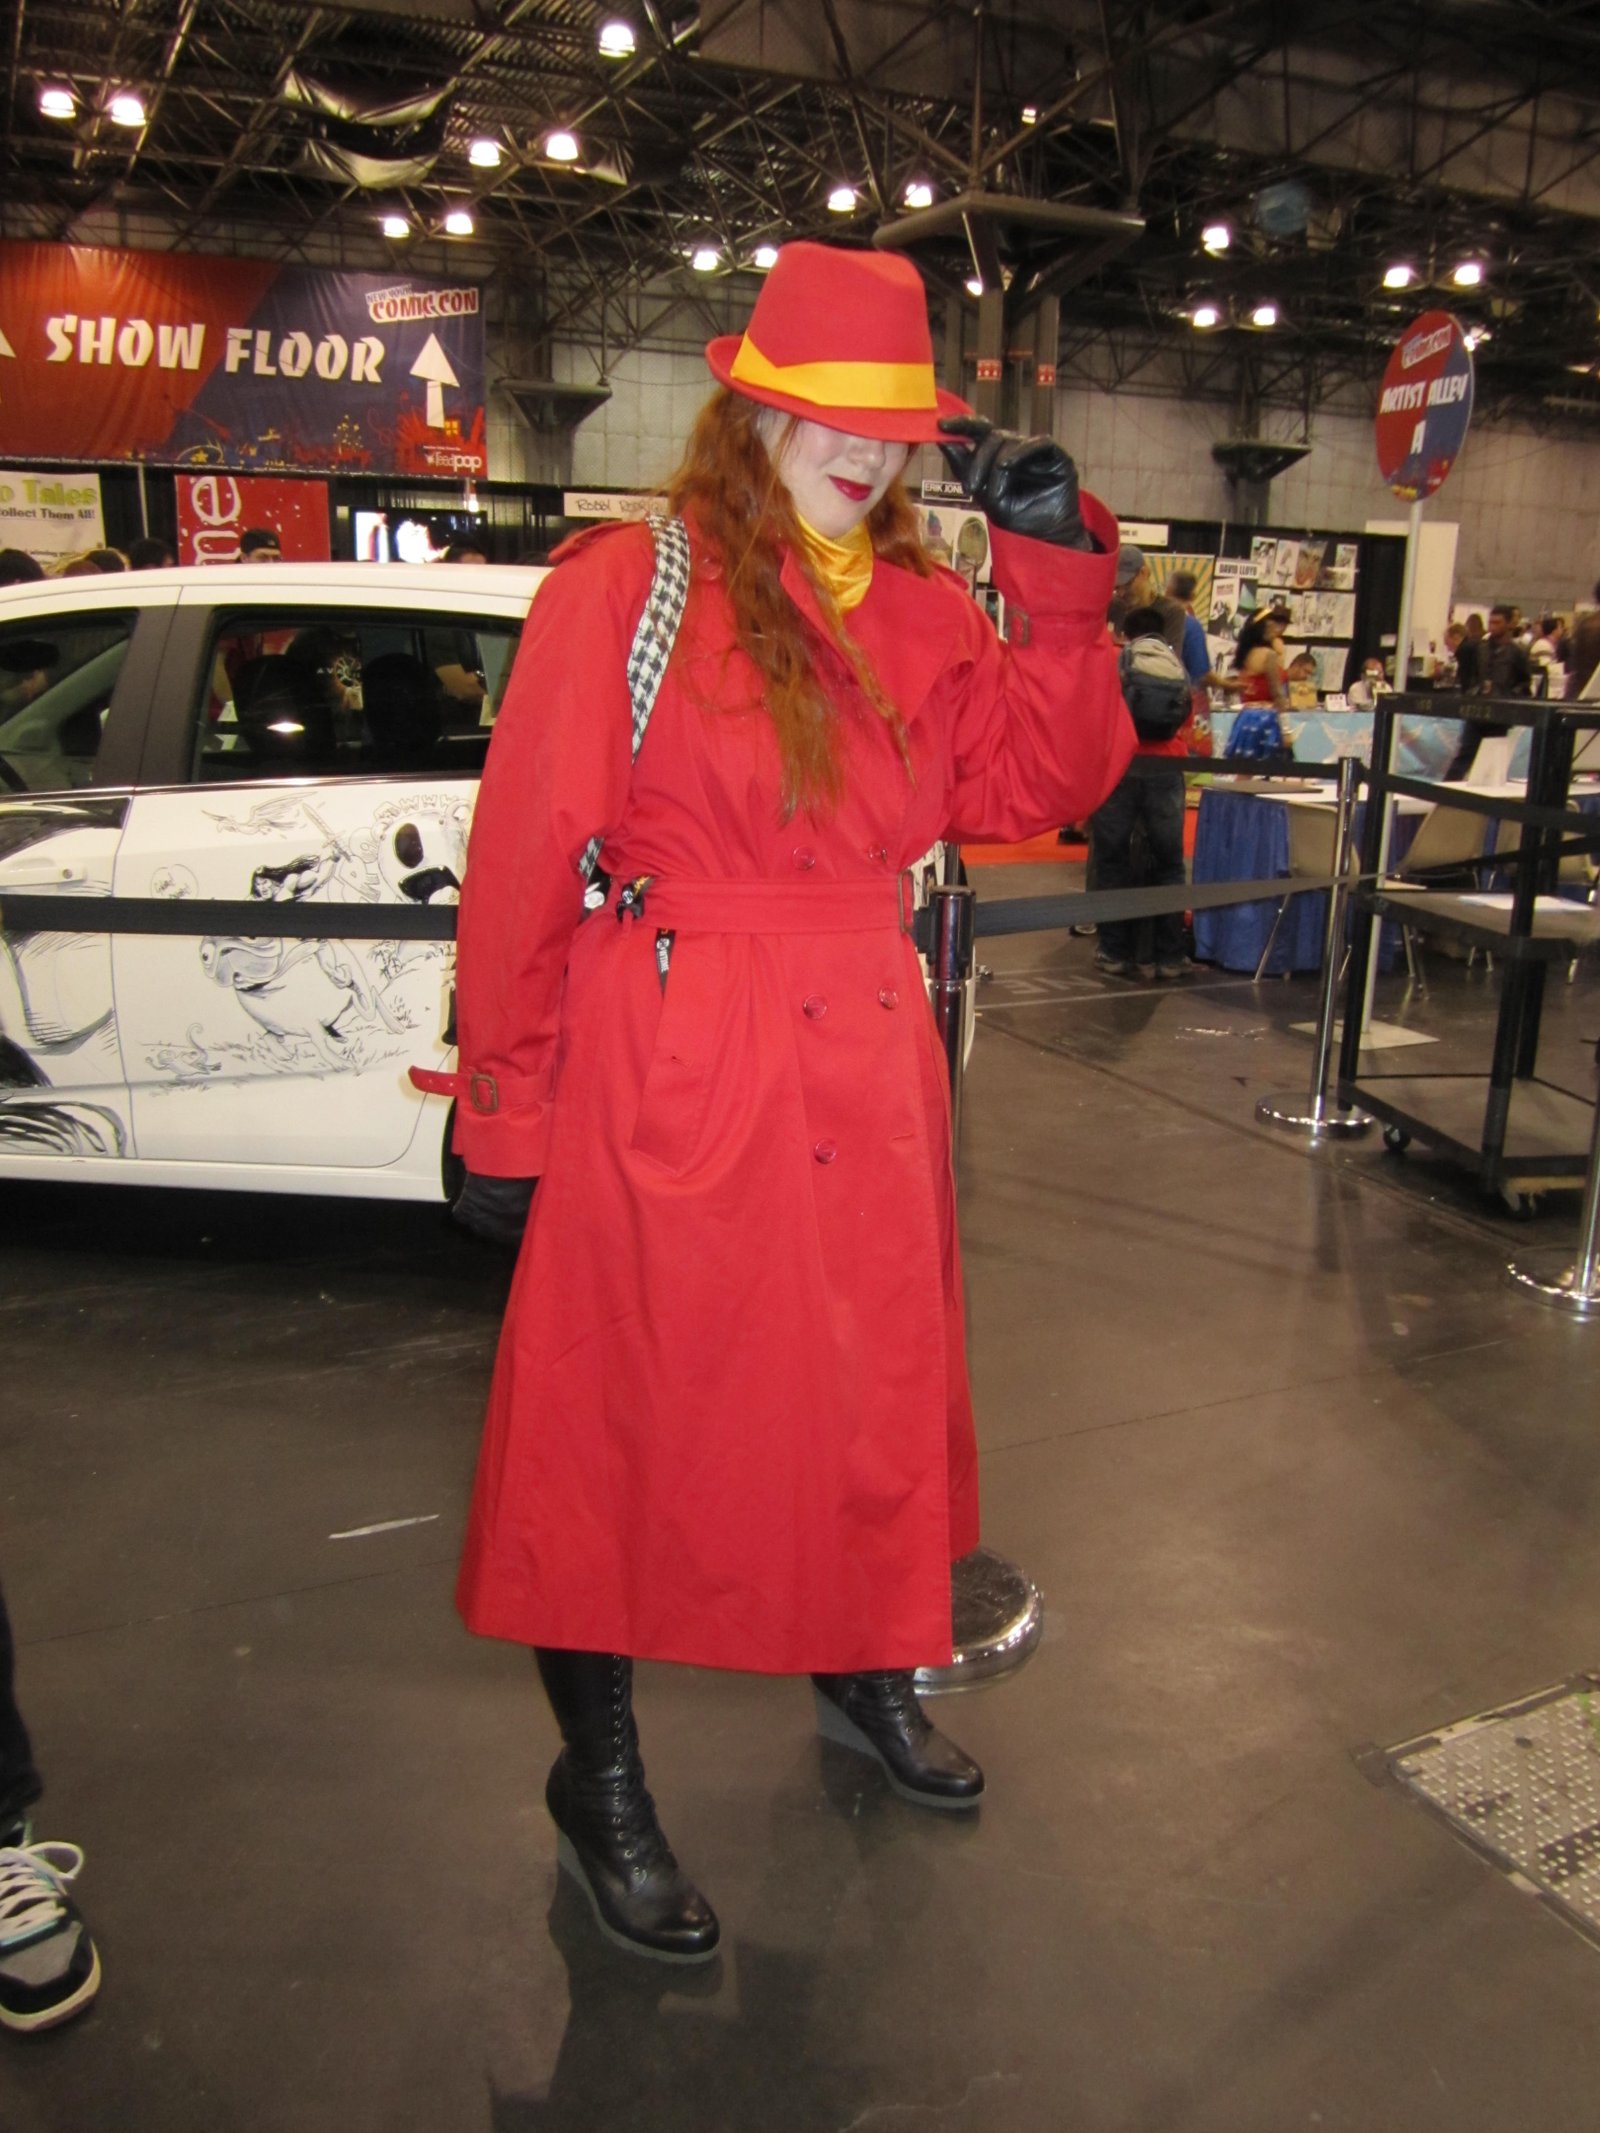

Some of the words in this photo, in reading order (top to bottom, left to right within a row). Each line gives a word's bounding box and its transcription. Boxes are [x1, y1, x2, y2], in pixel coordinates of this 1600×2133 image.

[372, 293, 435, 320] COMIC
[438, 290, 477, 313] CON
[46, 314, 206, 370] SHOW
[225, 327, 385, 383] FLOOR
[1380, 381, 1426, 414] ARTIST
[1426, 373, 1469, 407] ALLEY
[1410, 420, 1426, 455] A
[22, 478, 98, 506] Tales
[0, 507, 36, 518] ollect
[40, 508, 74, 520] Them
